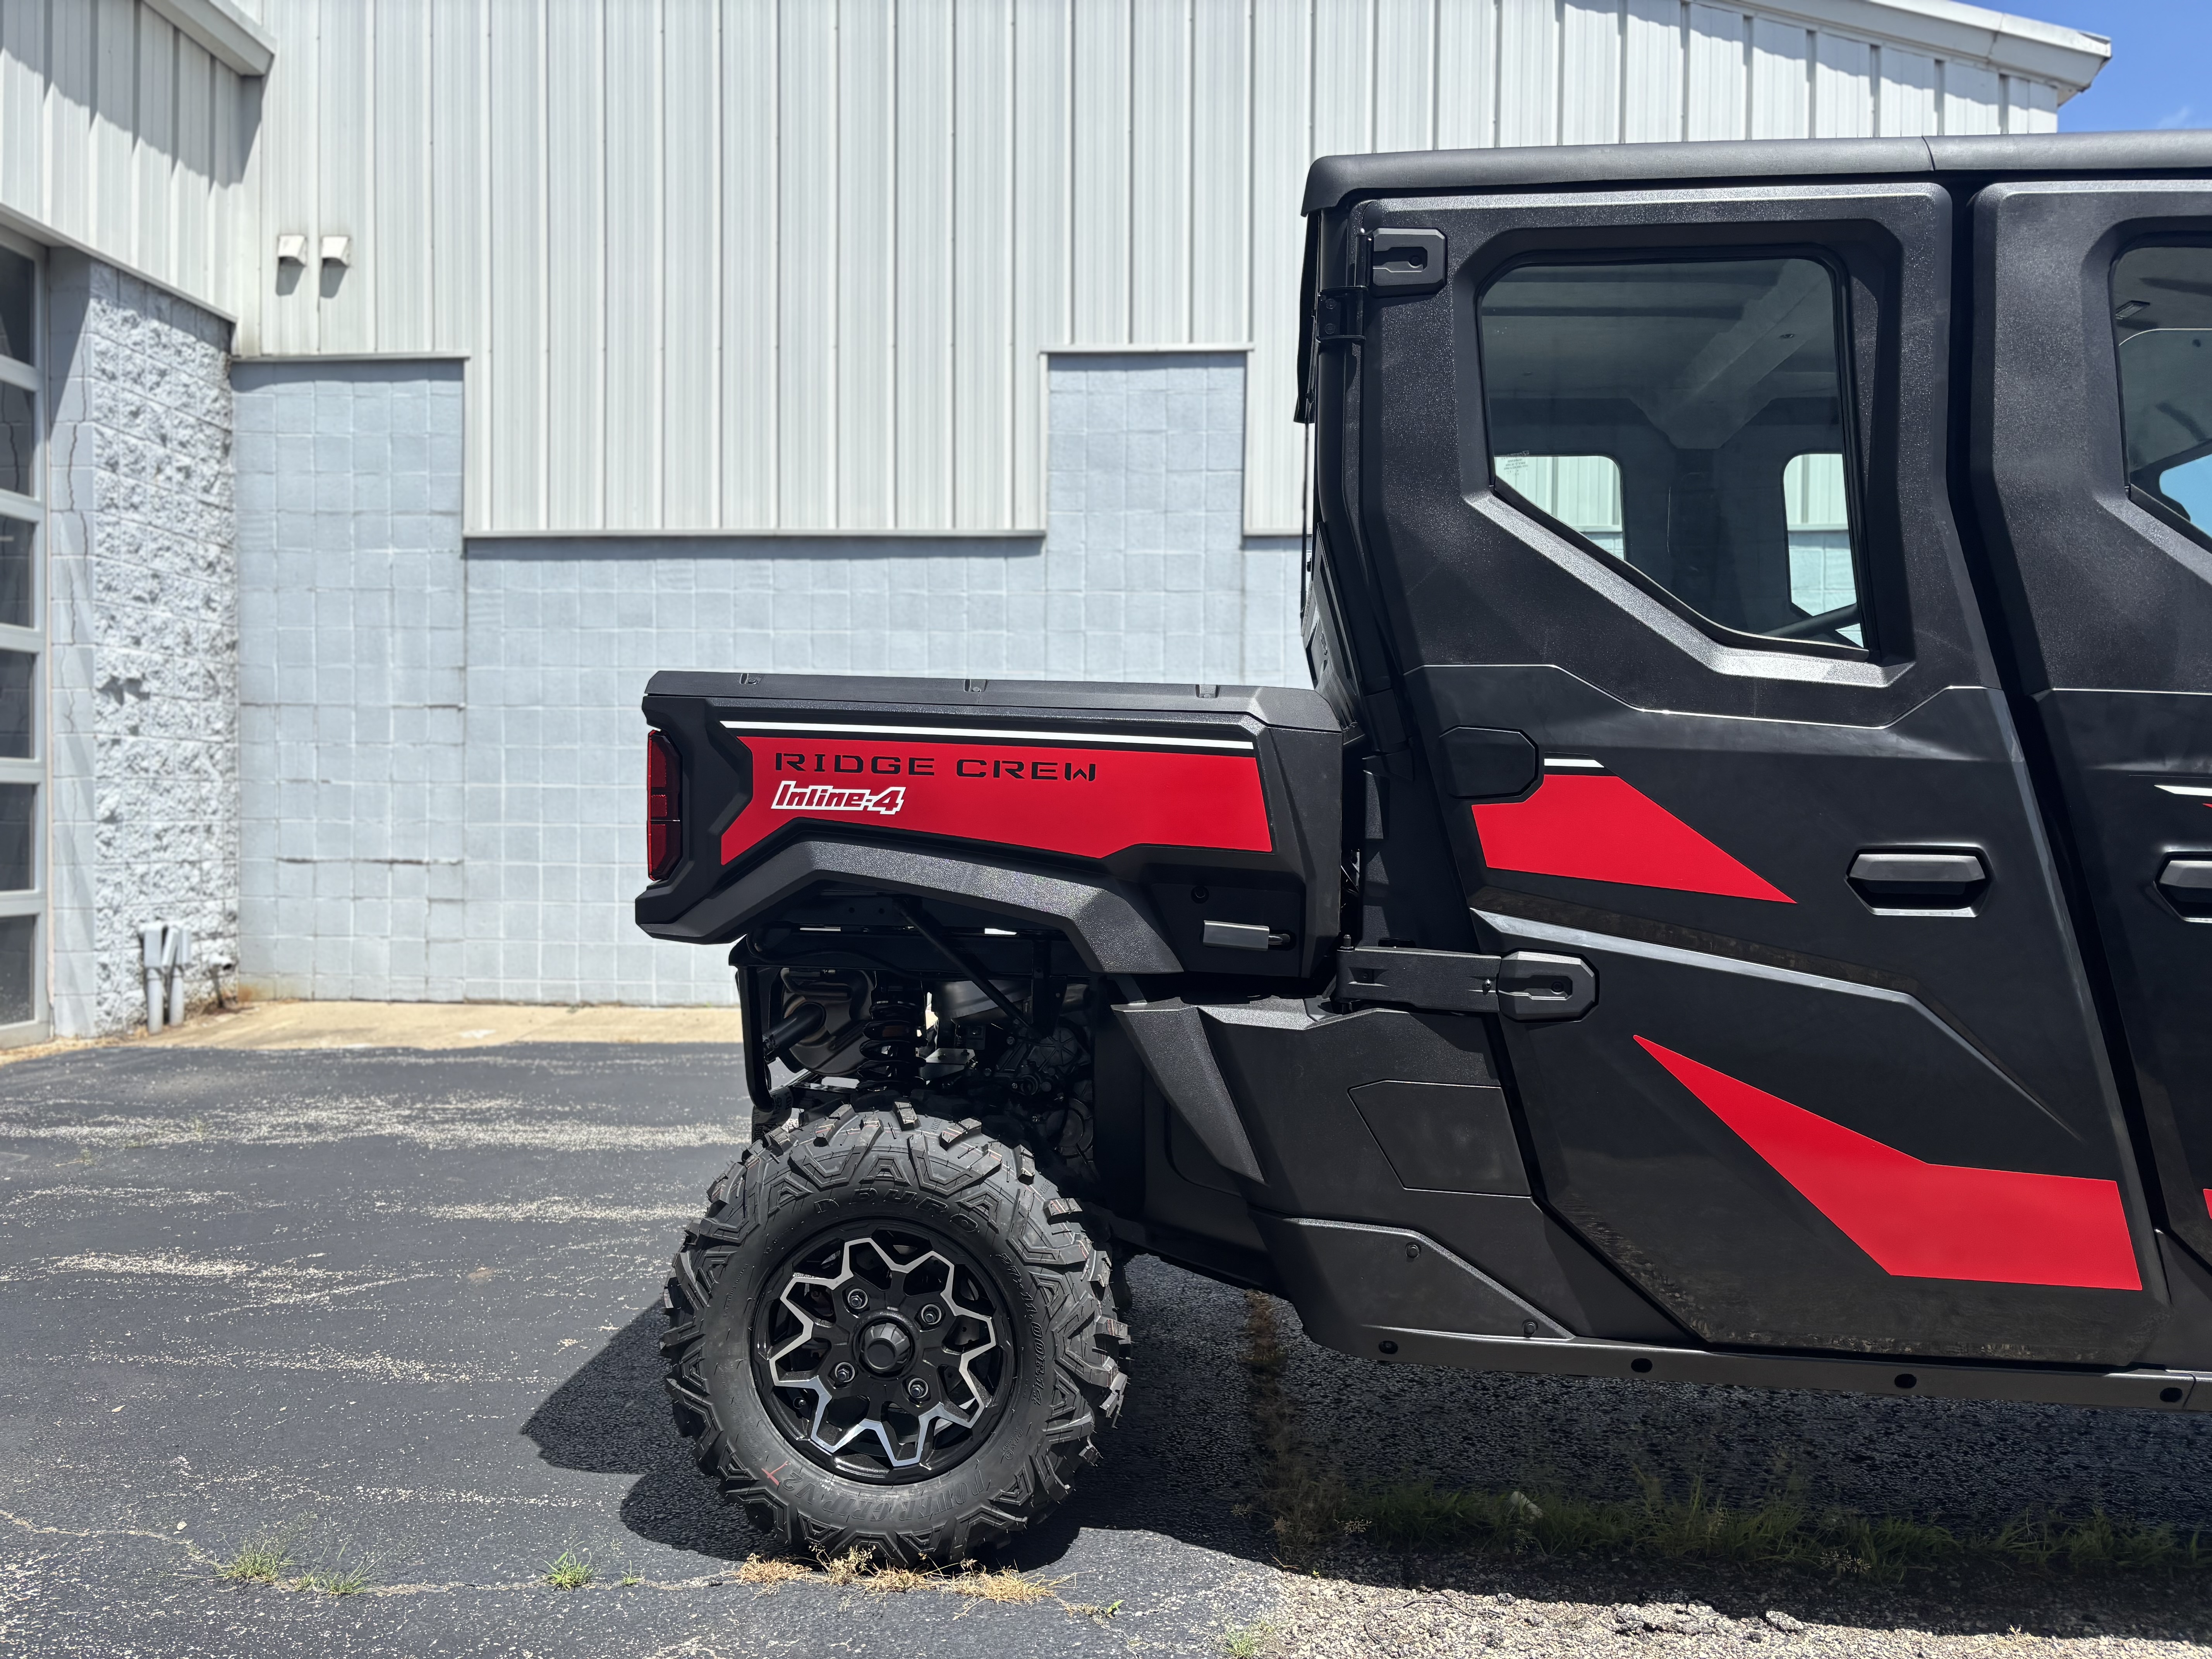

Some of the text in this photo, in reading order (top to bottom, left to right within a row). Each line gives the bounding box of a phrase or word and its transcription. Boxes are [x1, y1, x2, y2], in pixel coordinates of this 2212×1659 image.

[776, 752, 1096, 782] RIDGE CREW
[771, 780, 906, 815] Inline-4
[848, 1187, 980, 1233] DURO
[781, 1470, 984, 1522] POWER GRIP V2
